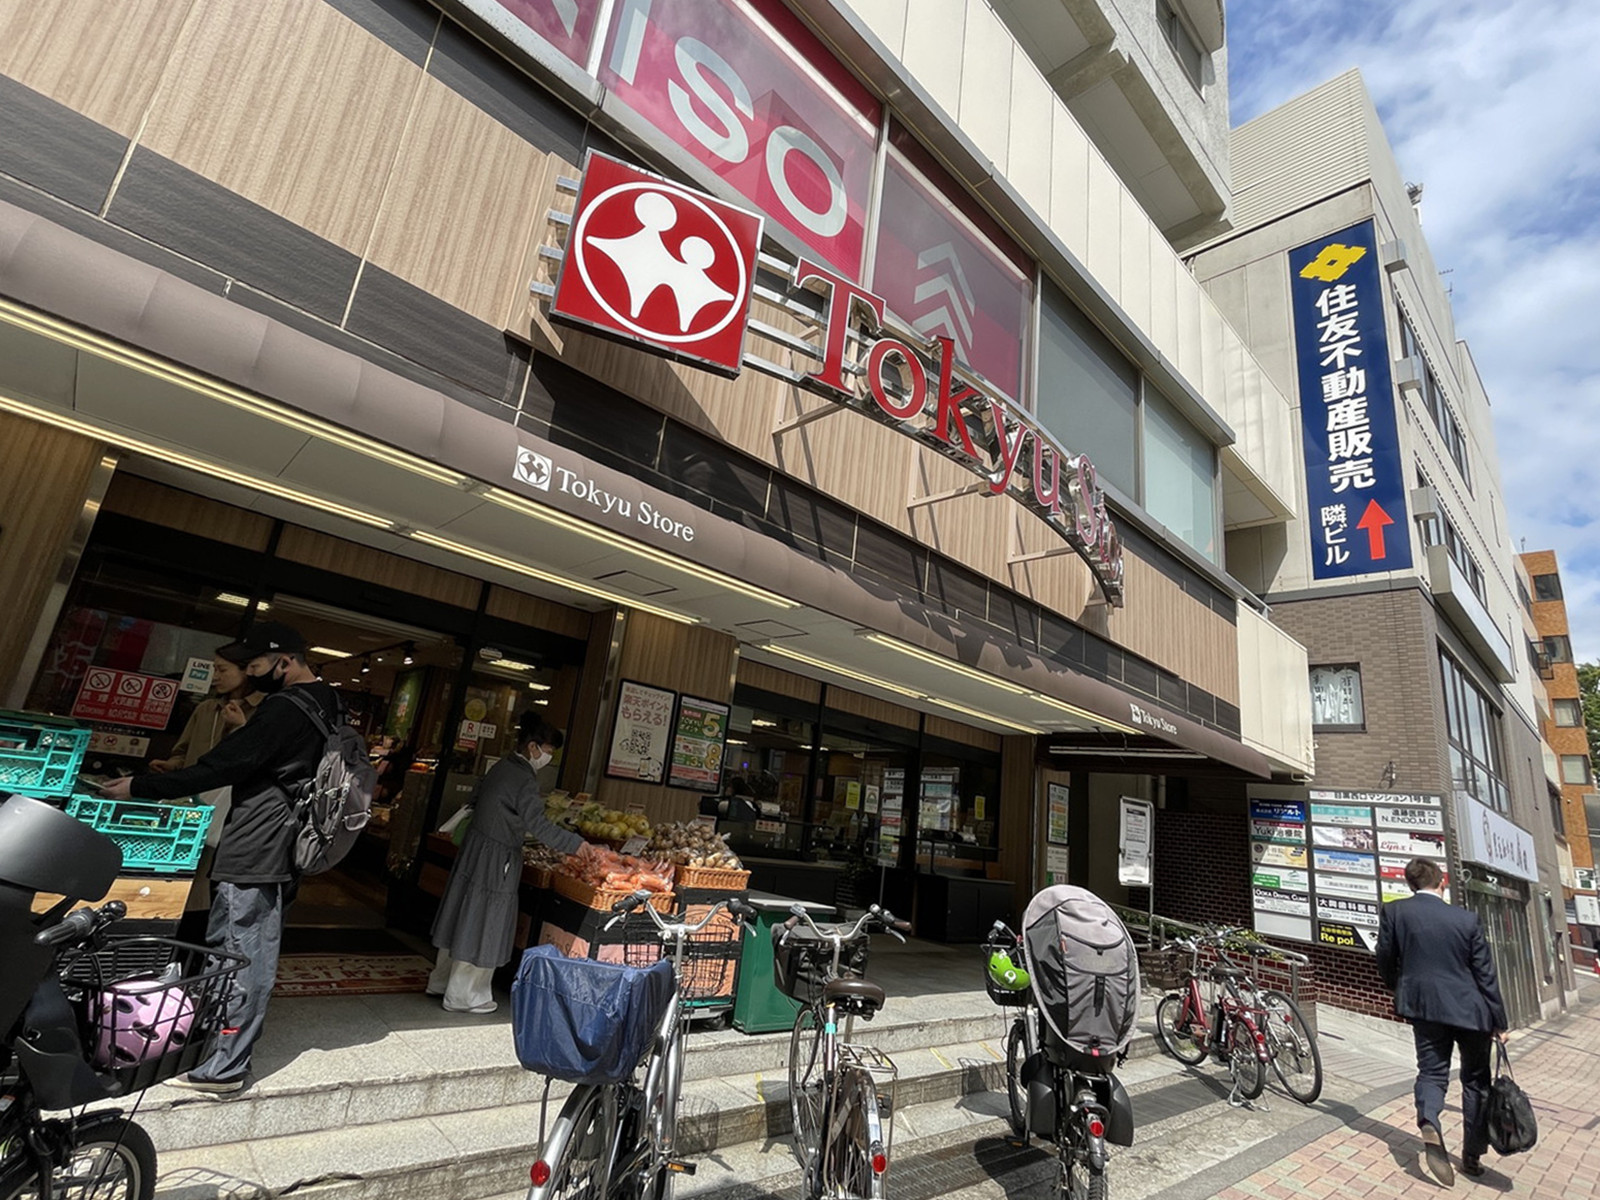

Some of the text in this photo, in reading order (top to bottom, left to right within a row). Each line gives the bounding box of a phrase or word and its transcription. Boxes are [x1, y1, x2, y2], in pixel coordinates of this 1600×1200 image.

[795, 256, 1062, 515] Tokyu
[1315, 283, 1376, 493] 住友不動産販売
[556, 467, 694, 542] Tokyu Store
[1320, 502, 1350, 566] 隣ビル
[1140, 709, 1178, 735] Tokyu Store
